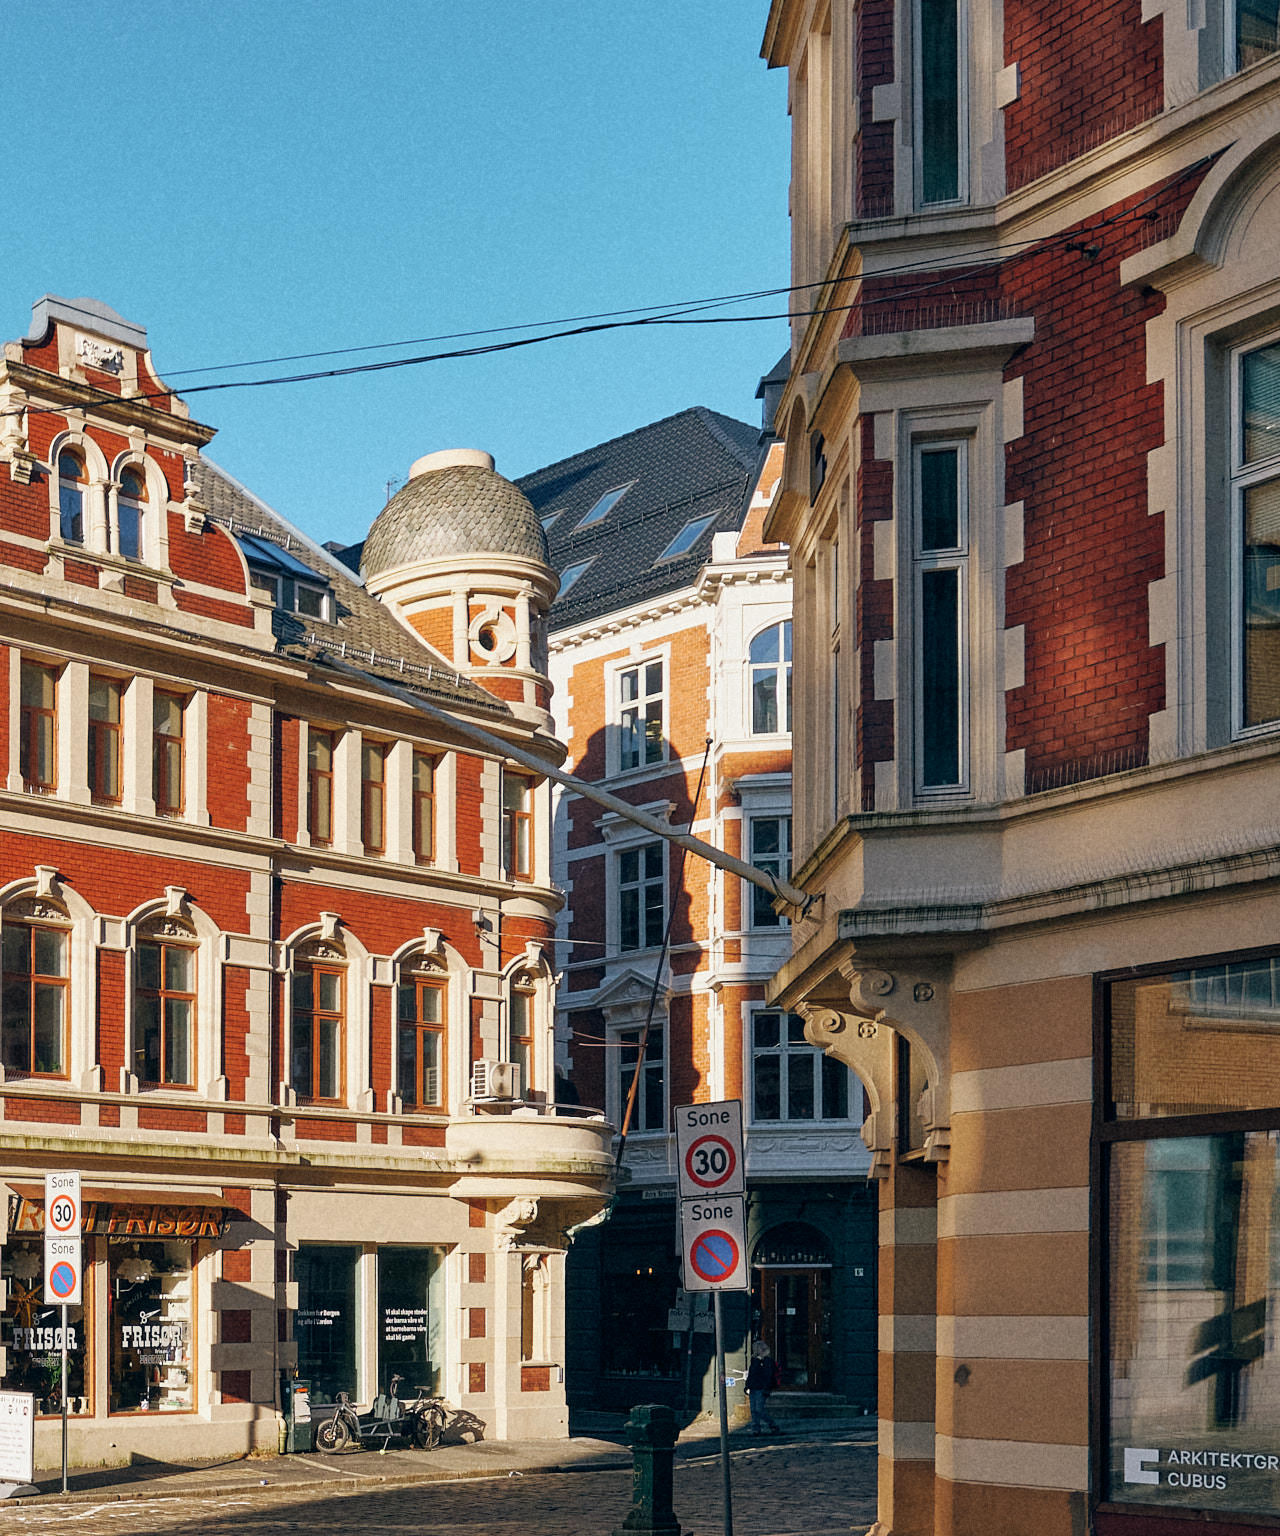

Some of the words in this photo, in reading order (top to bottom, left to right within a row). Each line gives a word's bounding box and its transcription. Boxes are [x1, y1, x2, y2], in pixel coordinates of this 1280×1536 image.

[687, 1111, 730, 1127] Sone
[695, 1148, 727, 1175] 30
[51, 1176, 75, 1188] Sone
[55, 1204, 72, 1222] 30
[107, 1202, 223, 1237] FRISØR
[691, 1205, 733, 1221] Sone
[51, 1242, 75, 1254] Sone
[13, 1327, 78, 1350] FRISØR
[122, 1325, 182, 1348] FRISØR
[1168, 1472, 1227, 1490] CUBUS
